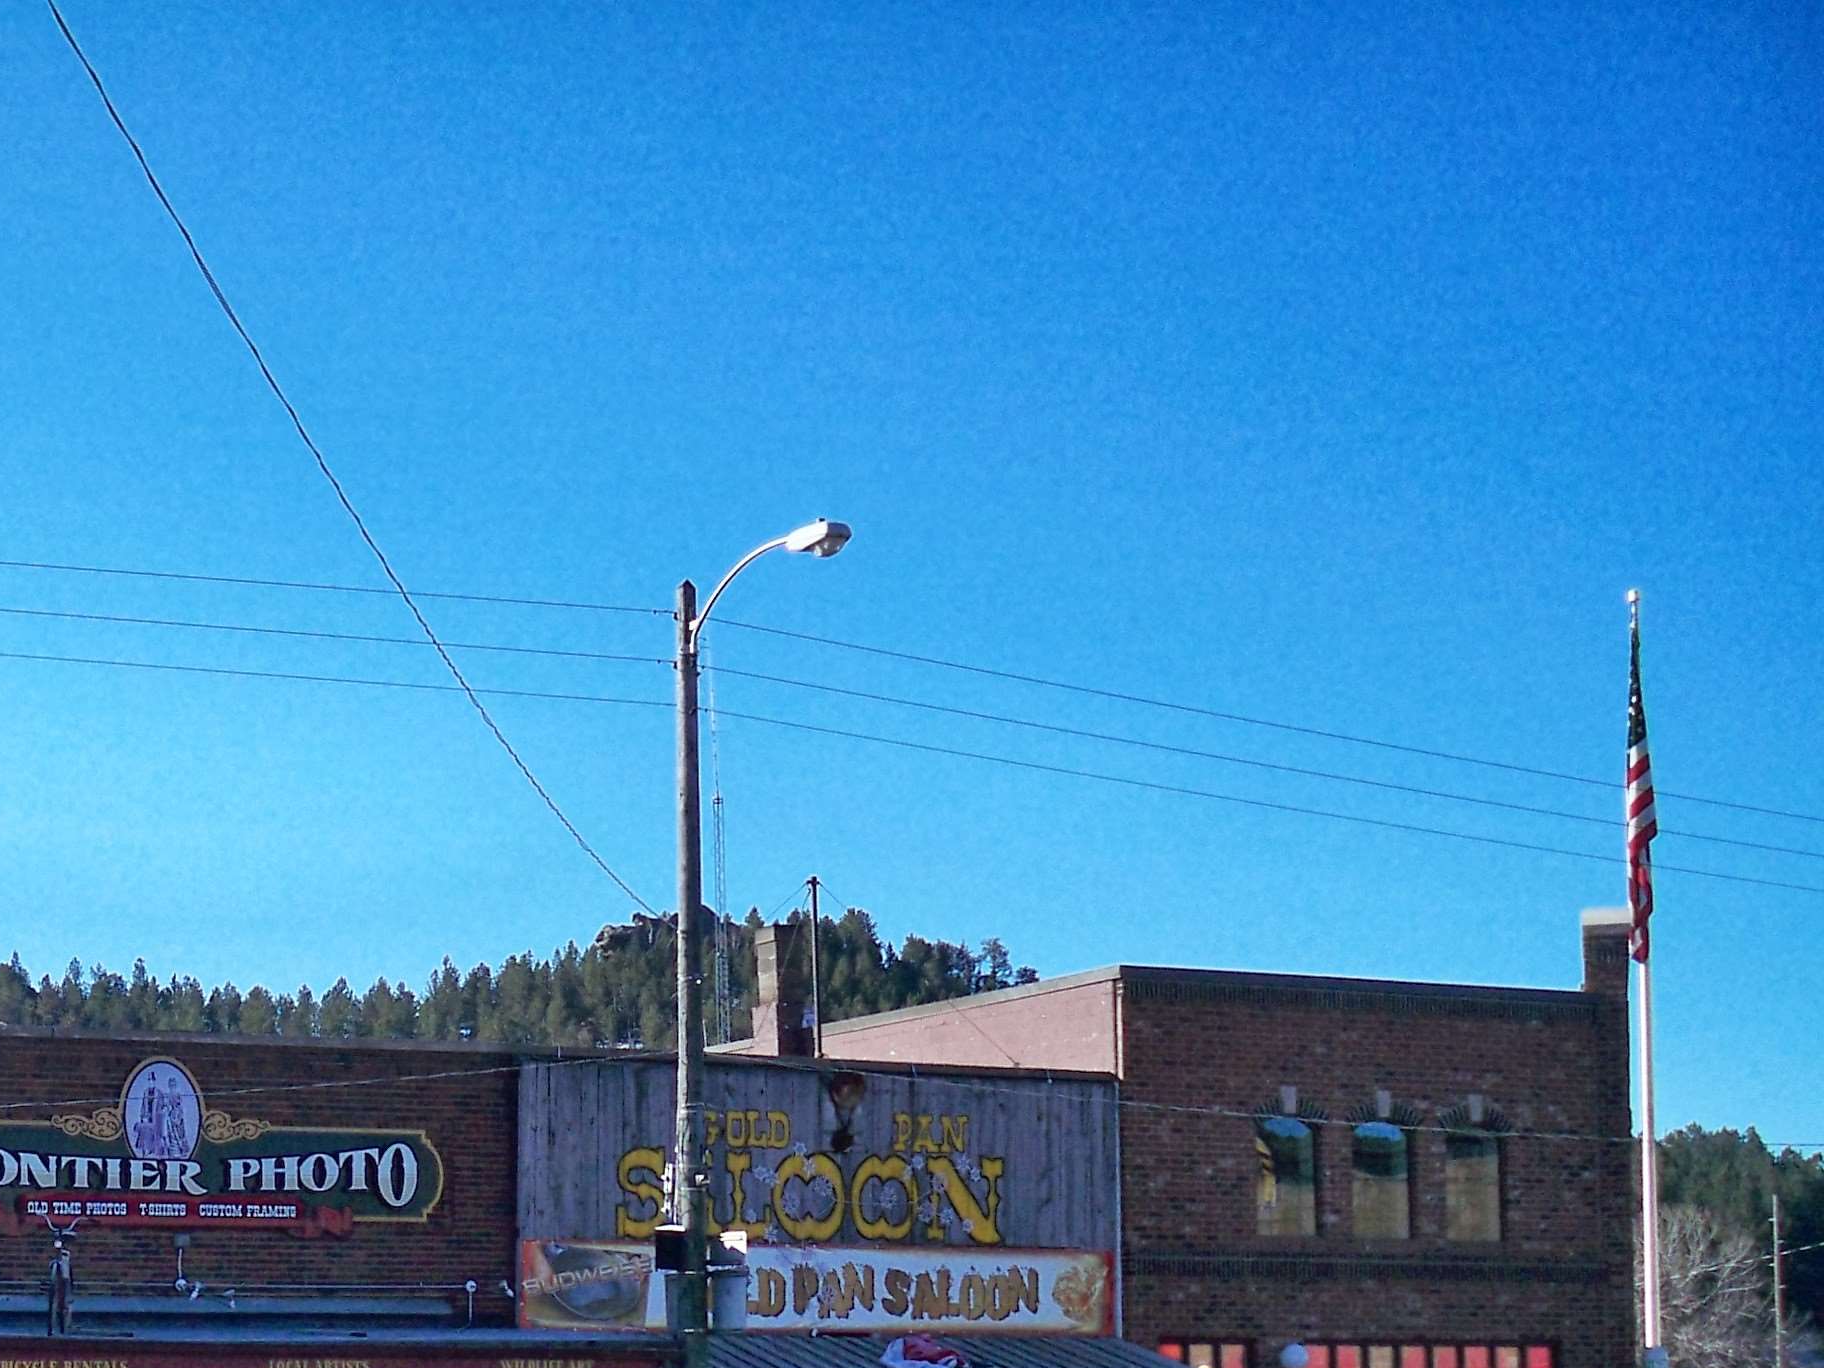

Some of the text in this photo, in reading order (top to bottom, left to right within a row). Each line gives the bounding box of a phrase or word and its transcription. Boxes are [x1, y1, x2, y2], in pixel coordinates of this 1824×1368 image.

[893, 1111, 970, 1152] PAN
[228, 1141, 419, 1207] PHOTO
[615, 1145, 1005, 1244] SLOON
[27, 1201, 297, 1218] OLD TIME PHOTOS T-SHIRTS CUSTOM FRAMING
[791, 1261, 876, 1320] PAN
[881, 1264, 1039, 1321] SALOON
